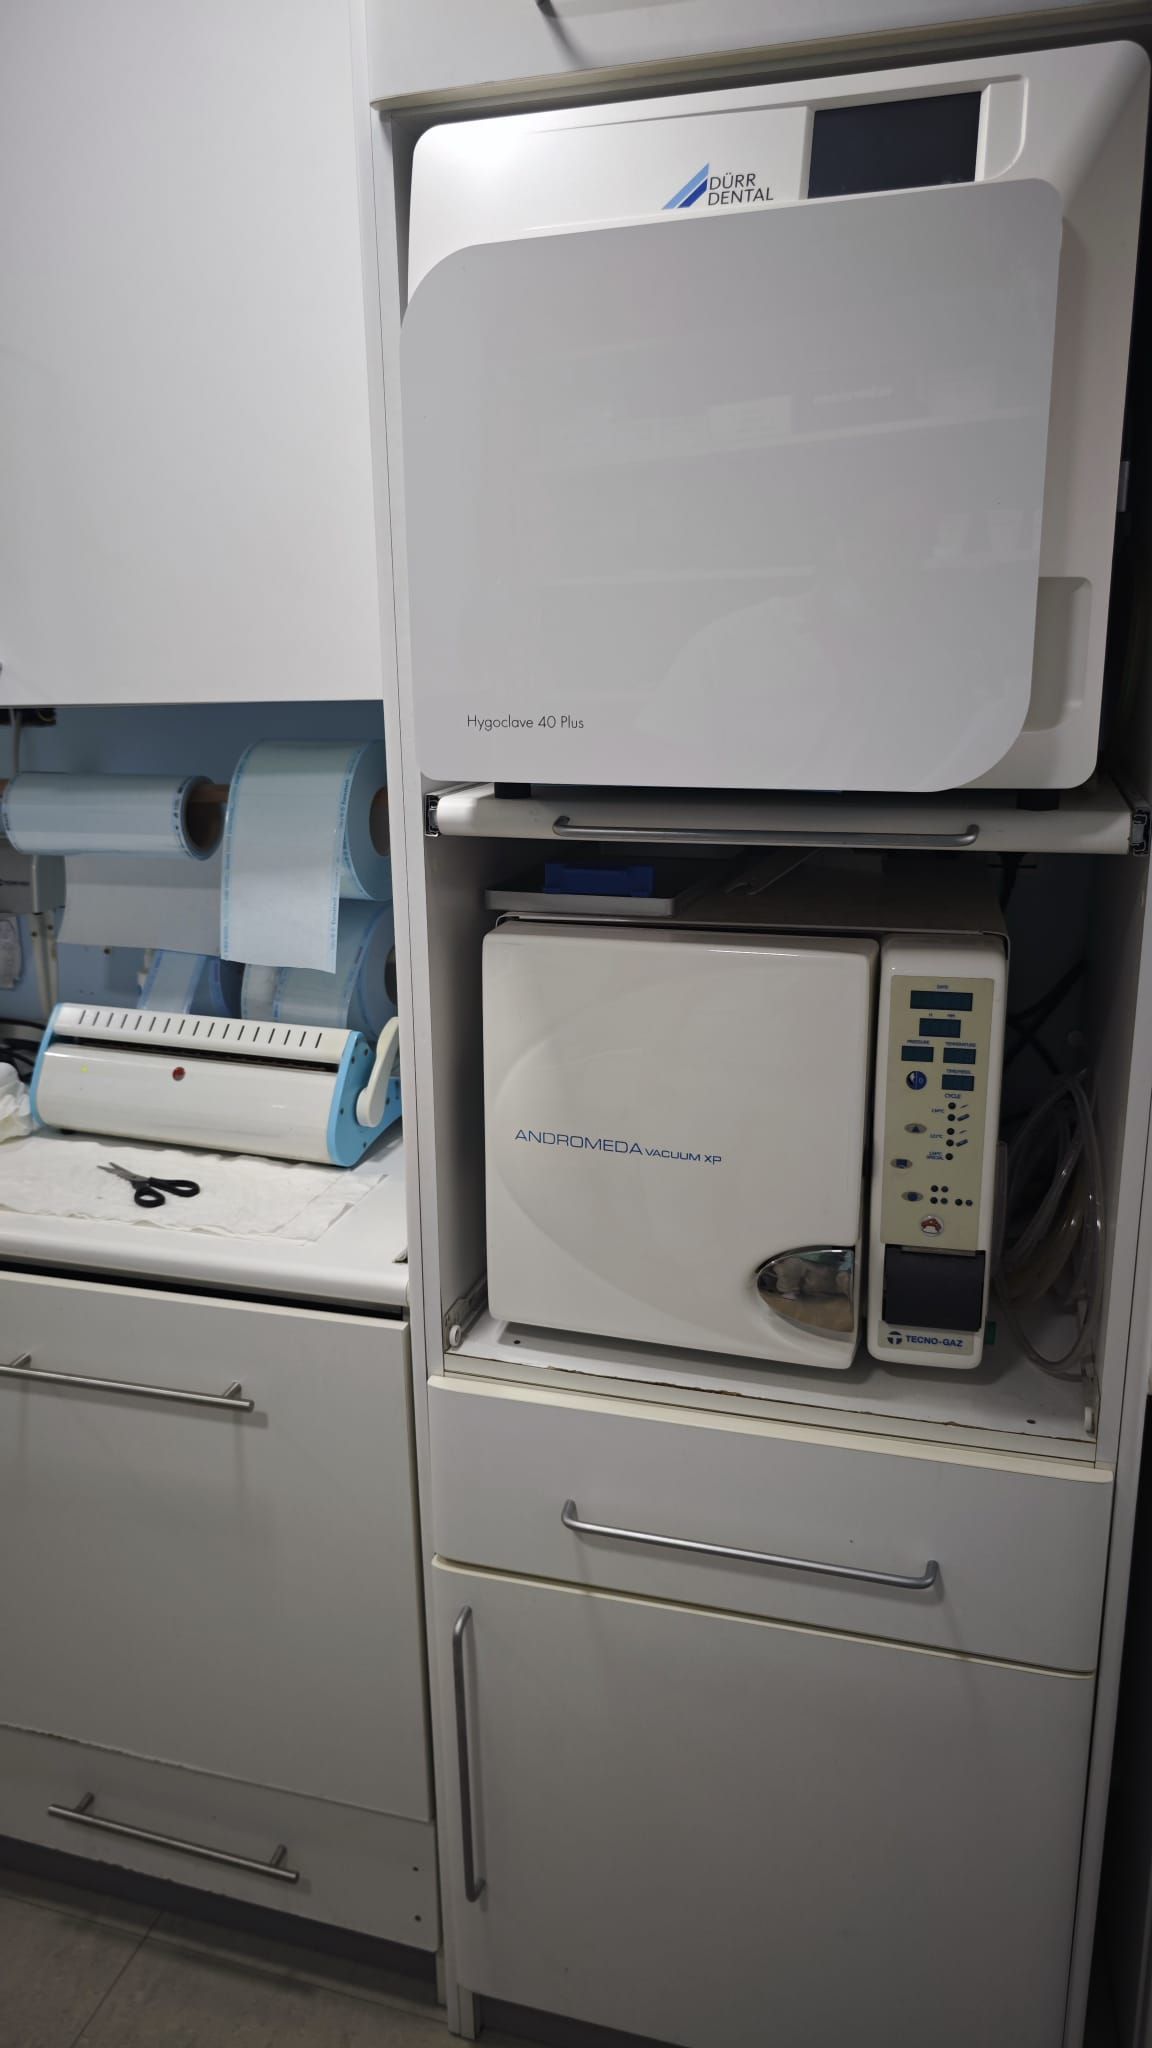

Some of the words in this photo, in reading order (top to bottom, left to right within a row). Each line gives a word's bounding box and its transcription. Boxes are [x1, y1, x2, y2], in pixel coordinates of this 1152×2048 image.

[709, 172, 757, 190] DÜRR
[708, 187, 774, 206] DENTAL
[467, 714, 534, 732] Hygoclave
[538, 715, 556, 728] 40
[560, 714, 584, 728] Plus
[515, 1129, 643, 1156] ANDROMEDA
[644, 1148, 701, 1162] VACUUM
[704, 1154, 722, 1165] XP
[906, 1335, 963, 1348] TECNO-GAZ
